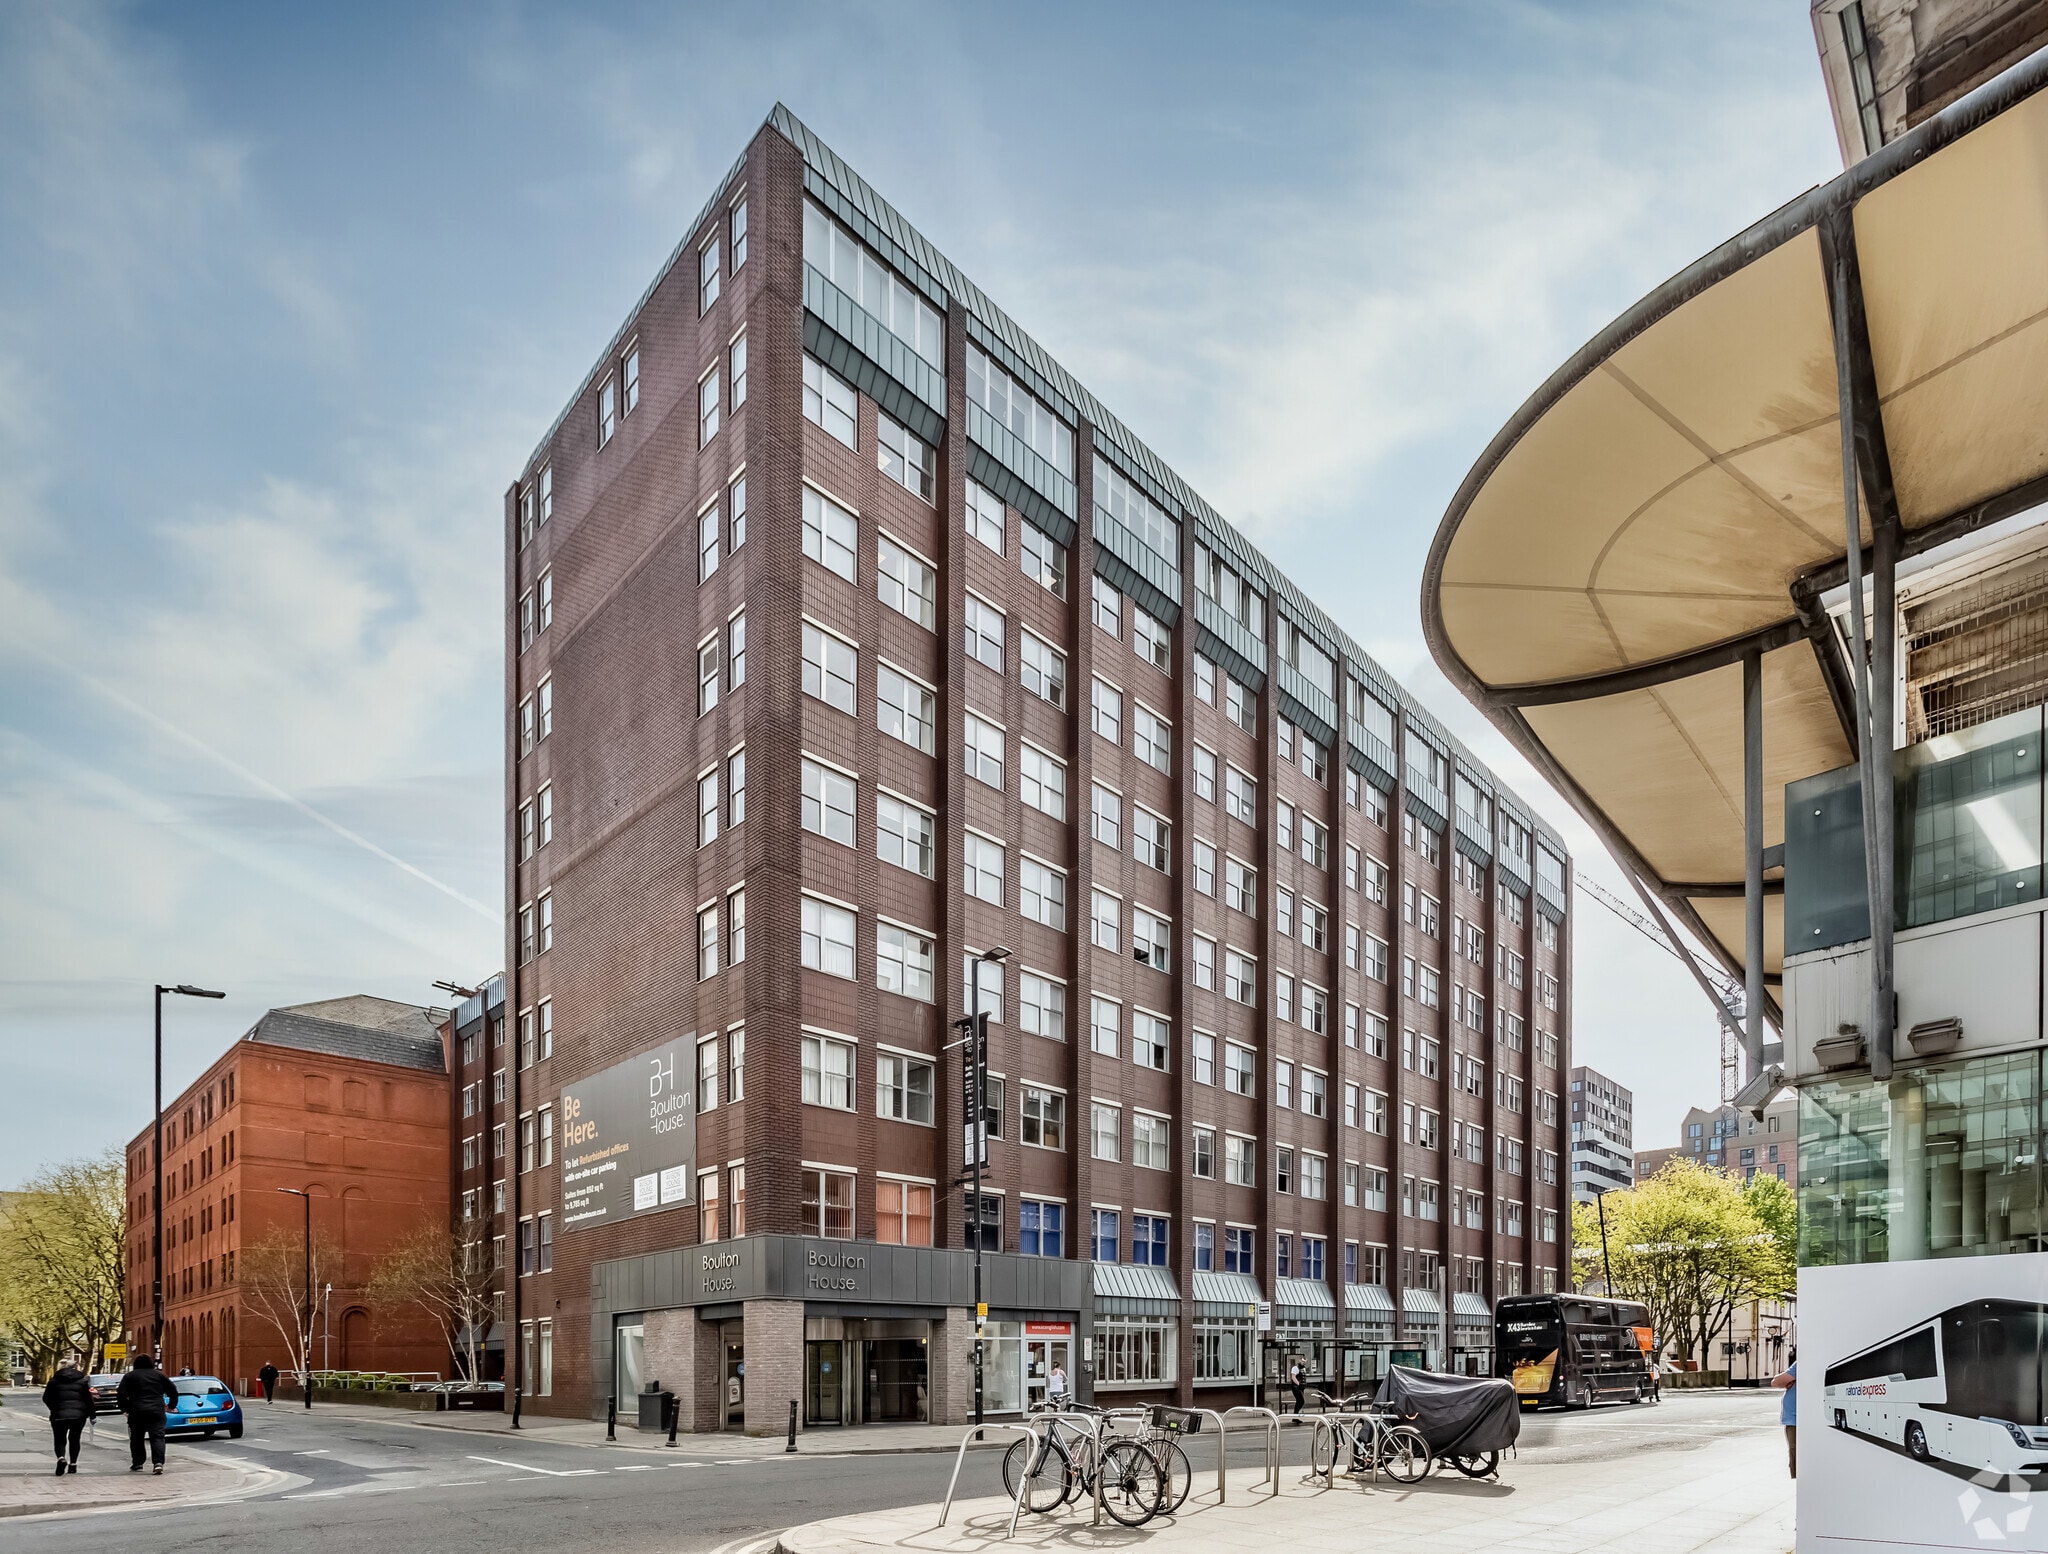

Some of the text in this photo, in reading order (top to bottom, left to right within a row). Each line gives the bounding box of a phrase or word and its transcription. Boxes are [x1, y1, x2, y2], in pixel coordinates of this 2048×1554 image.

[564, 1095, 580, 1121] Be
[650, 1092, 691, 1118] Boulton
[650, 1113, 686, 1135] House.
[564, 1120, 598, 1148] Here.
[564, 1160, 571, 1169] To
[611, 1143, 629, 1156] offices
[564, 1161, 617, 1183] with on-site car parking
[564, 1191, 576, 1200] Suites
[577, 1188, 586, 1197] from
[702, 1252, 740, 1271] Boulton
[808, 1250, 866, 1269] Boulton
[702, 1277, 736, 1293] House.
[808, 1273, 860, 1291] House.
[1507, 1322, 1520, 1333] X43
[1862, 1383, 1887, 1400] express
